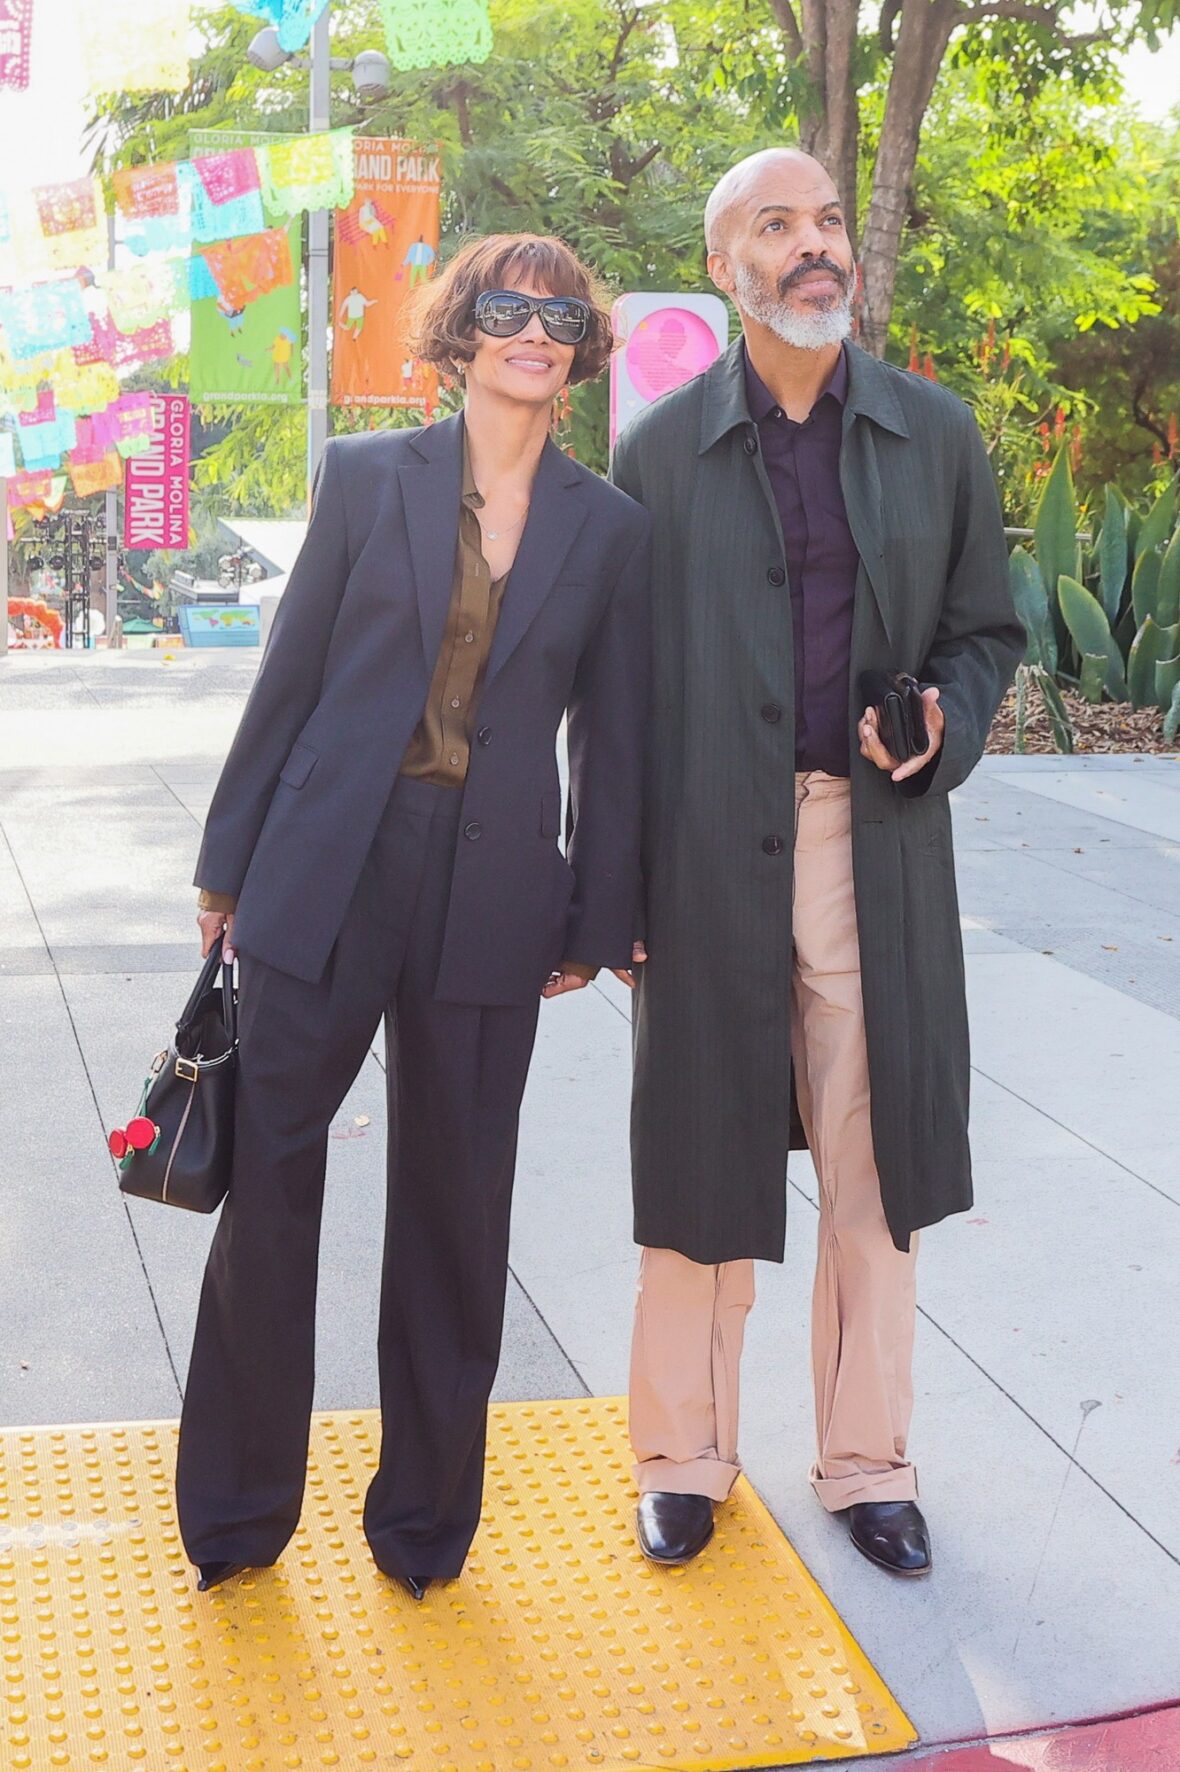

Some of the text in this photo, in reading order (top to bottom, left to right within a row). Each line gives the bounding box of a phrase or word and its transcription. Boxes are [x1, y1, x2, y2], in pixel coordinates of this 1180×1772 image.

[193, 133, 243, 145] GLORIA
[354, 140, 385, 151] ORIA
[353, 153, 441, 183] AND PARK
[168, 400, 184, 544] GLORIA MOLINA
[129, 483, 166, 544] PARK
